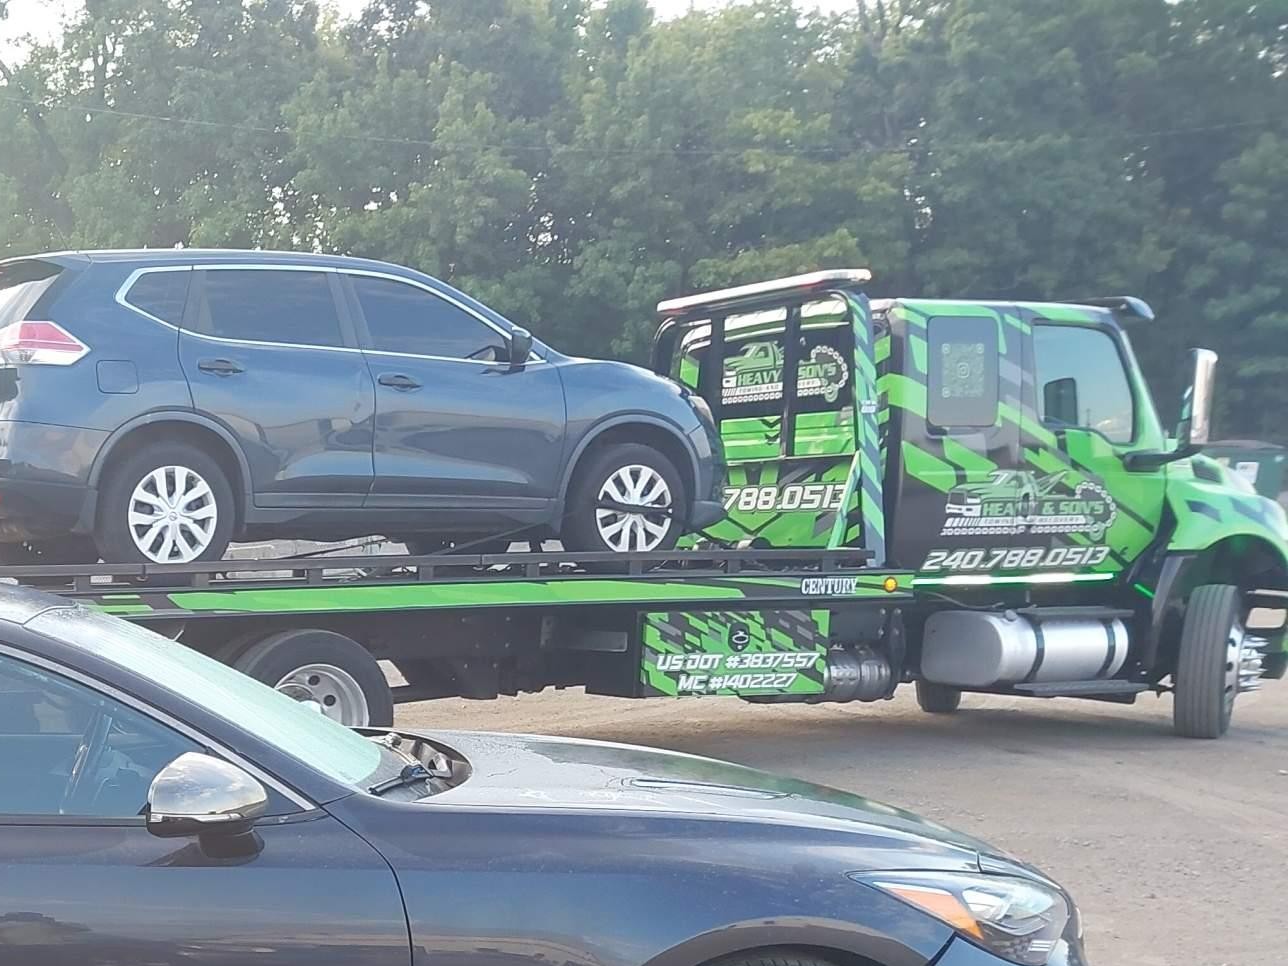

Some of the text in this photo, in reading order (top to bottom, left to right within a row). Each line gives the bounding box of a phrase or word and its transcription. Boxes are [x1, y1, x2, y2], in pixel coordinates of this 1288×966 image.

[737, 368, 782, 386] HEAVY
[724, 485, 847, 512] 788.0513
[983, 502, 1039, 517] HEA
[1042, 502, 1055, 515] &
[921, 546, 1110, 571] 240.788.0513
[801, 577, 857, 595] CENTURY
[657, 652, 820, 670] US DOT #3837557
[678, 672, 798, 690] MC #1402227
